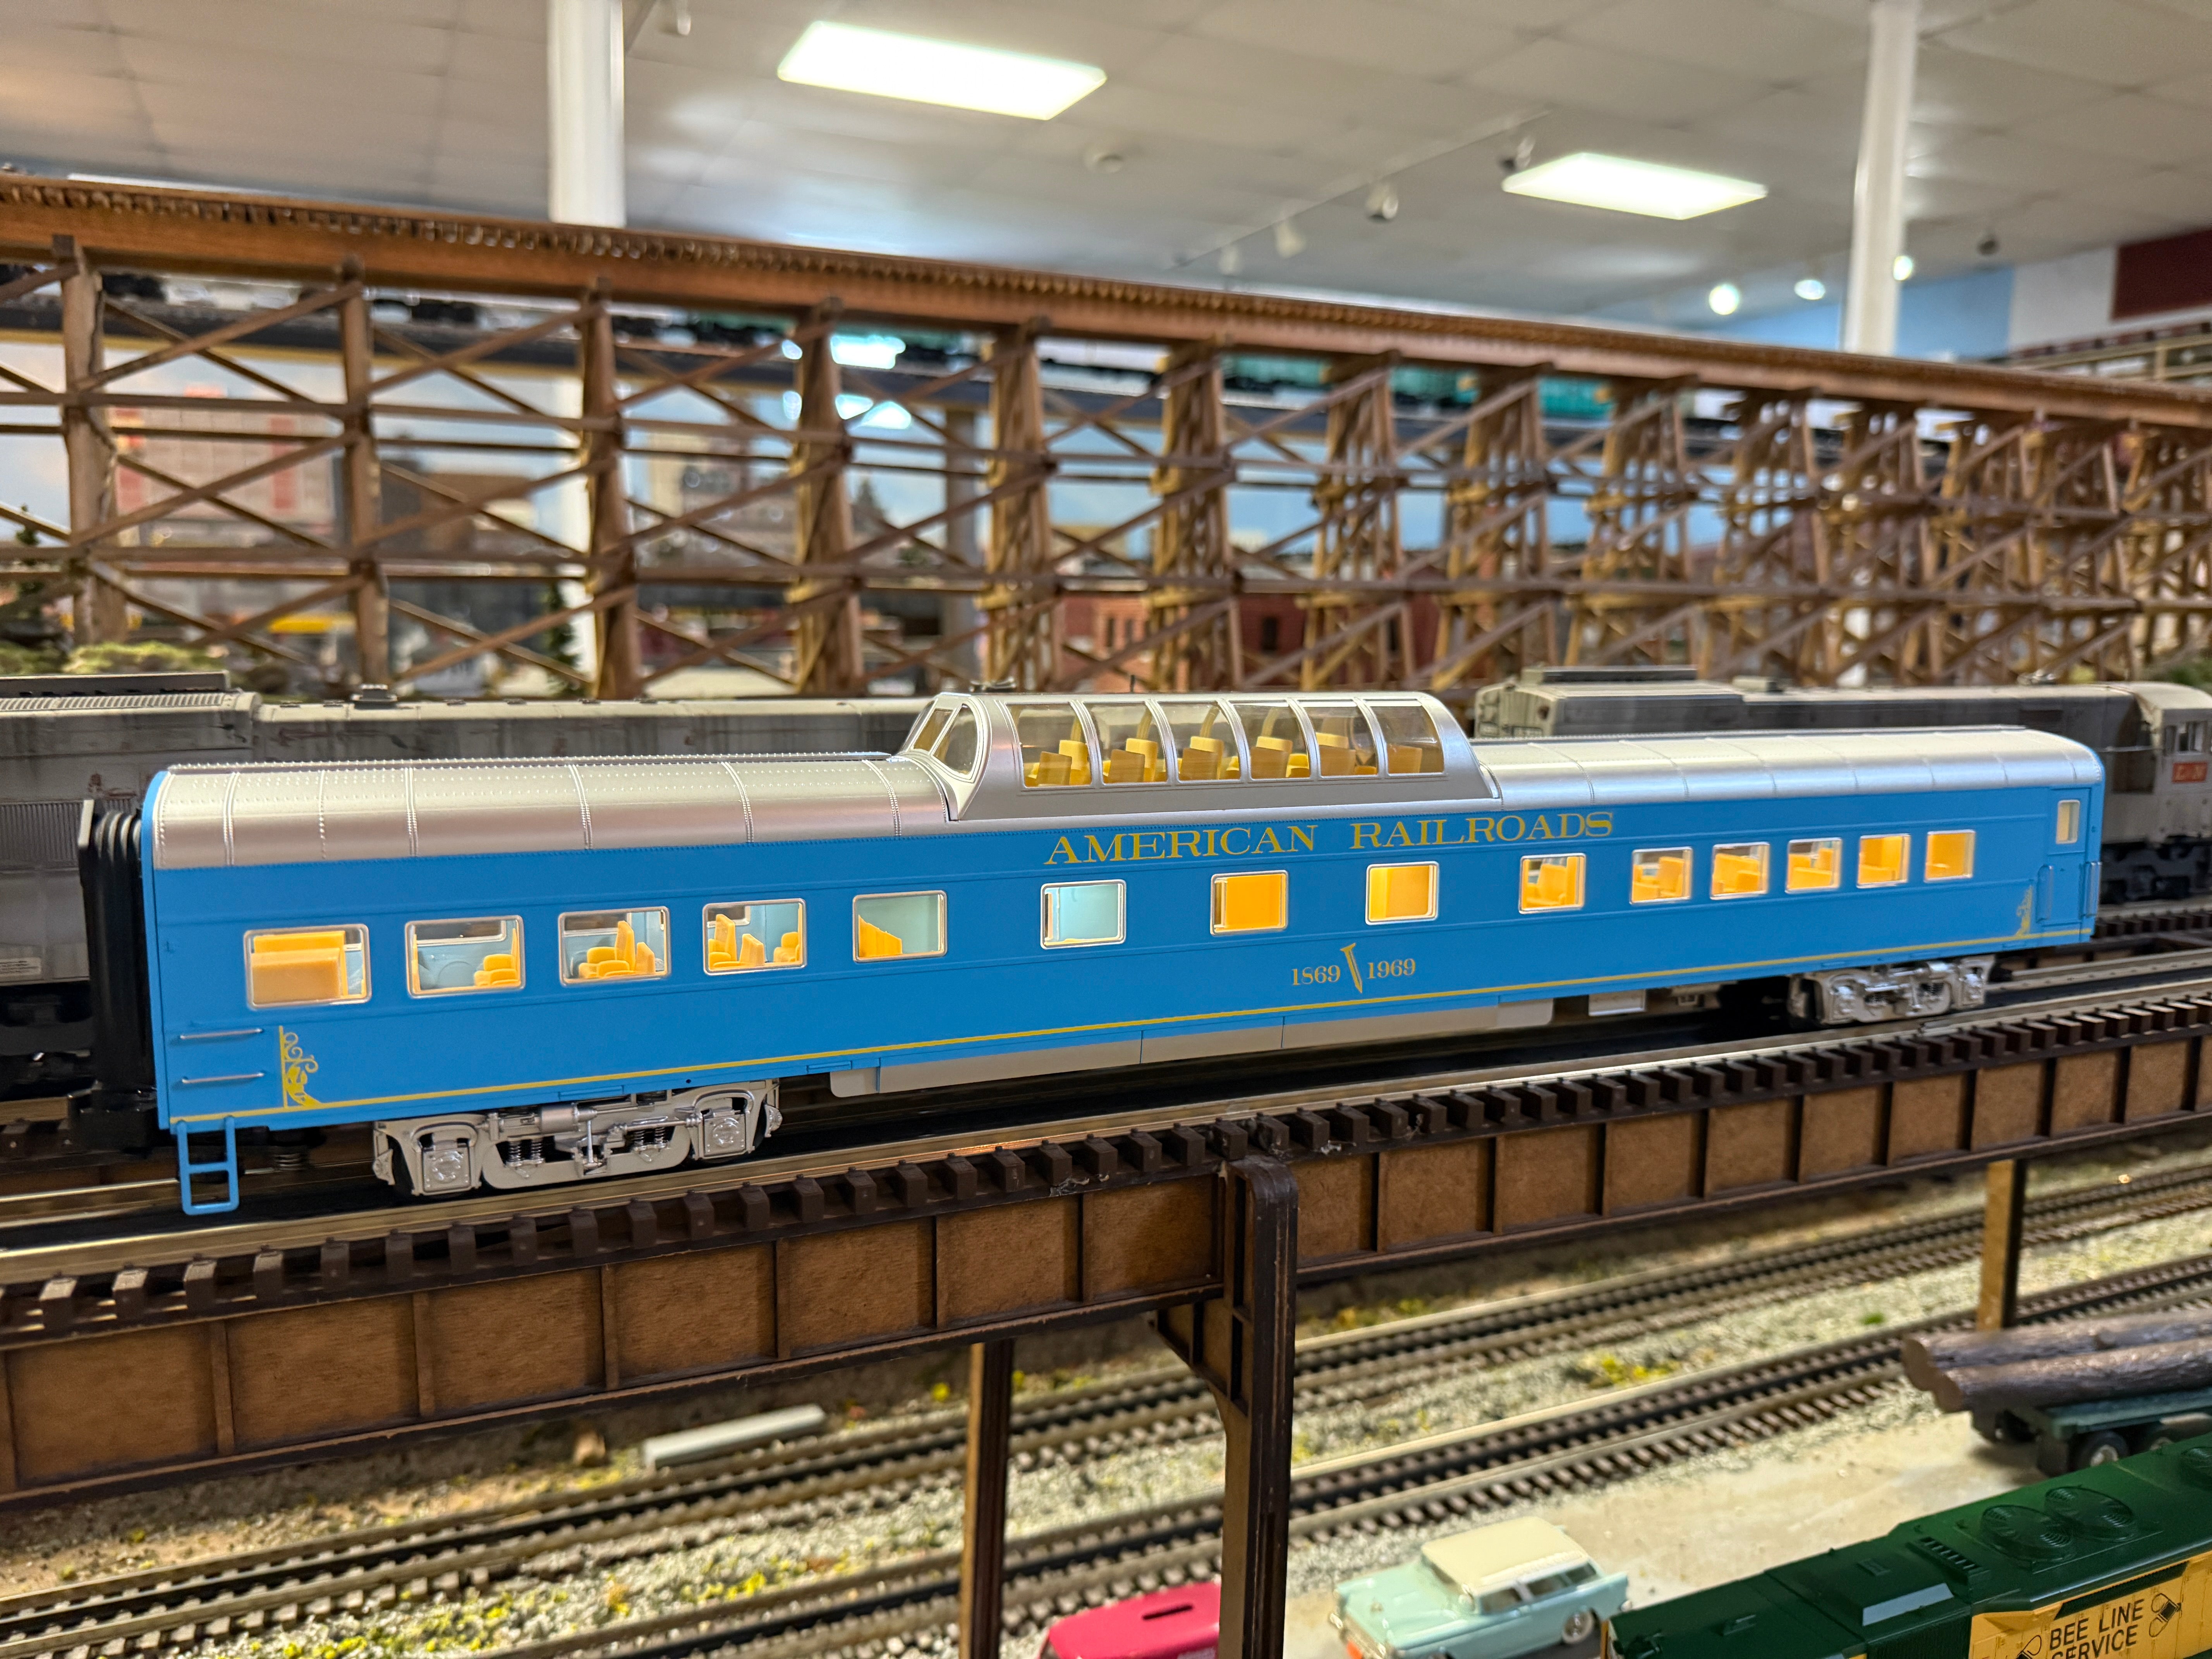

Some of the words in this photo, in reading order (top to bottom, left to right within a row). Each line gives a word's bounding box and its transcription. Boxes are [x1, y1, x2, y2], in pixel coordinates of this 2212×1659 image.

[1043, 825, 1318, 865] AMERICAN
[1350, 812, 1613, 849] RAILROADS
[1291, 965, 1341, 986] 1869
[1367, 958, 1416, 979] 1969
[2050, 1618, 2088, 1650] BEE
[2099, 1599, 2144, 1633] LINE
